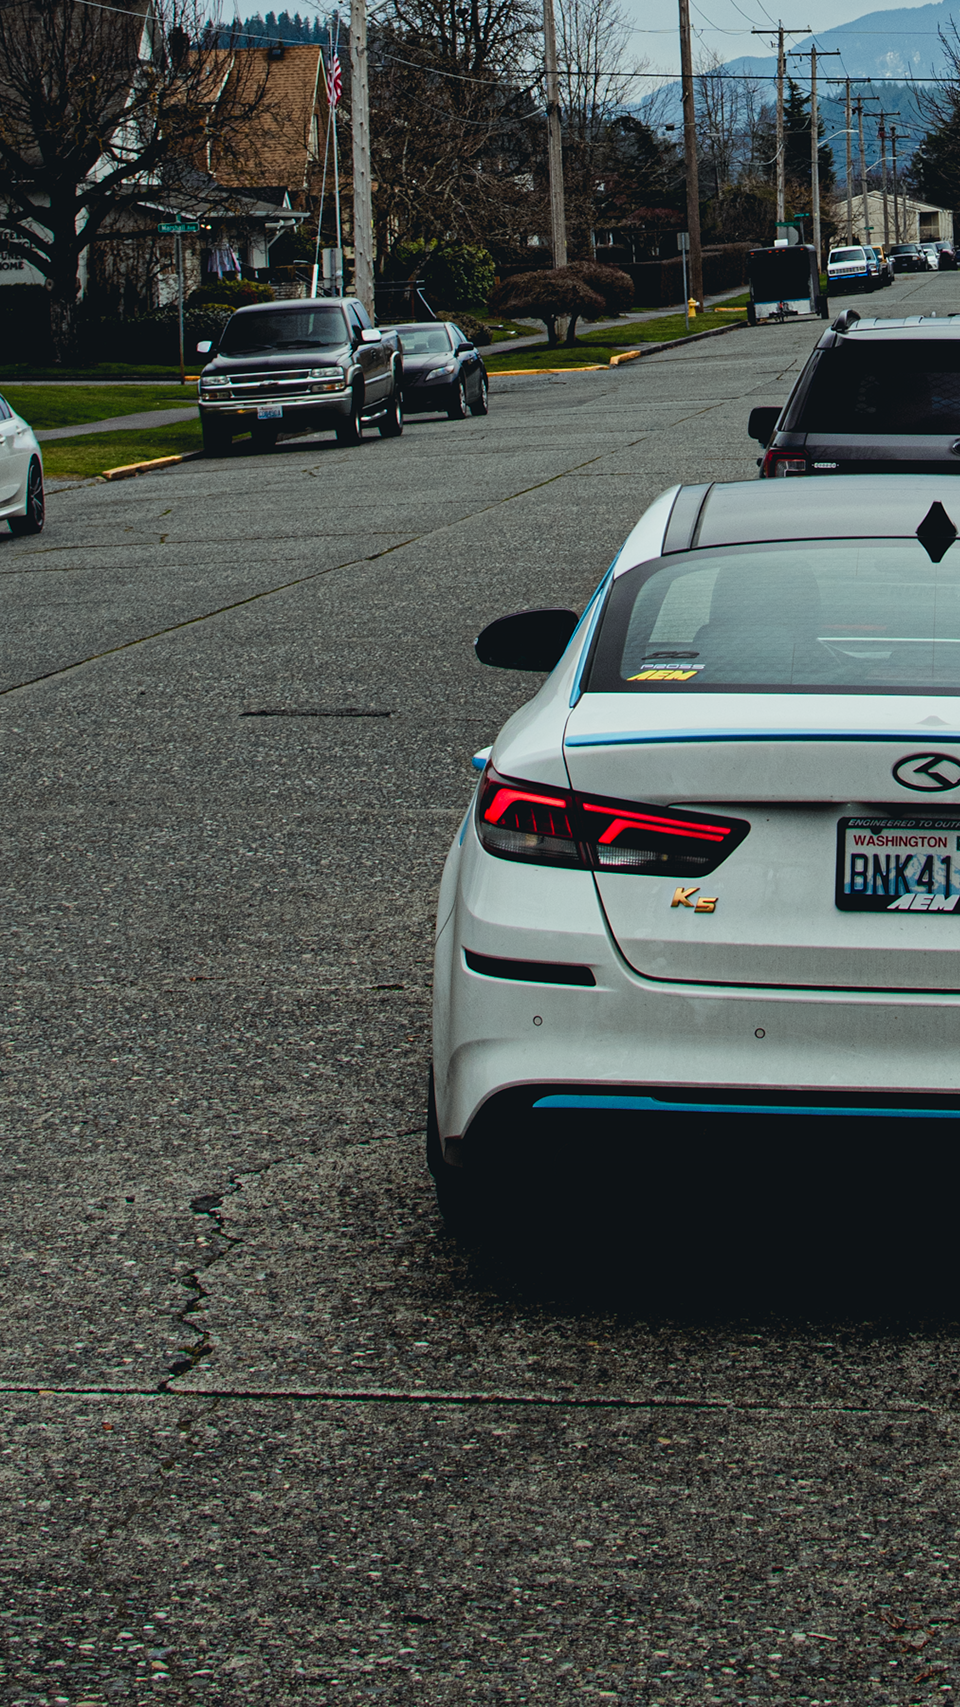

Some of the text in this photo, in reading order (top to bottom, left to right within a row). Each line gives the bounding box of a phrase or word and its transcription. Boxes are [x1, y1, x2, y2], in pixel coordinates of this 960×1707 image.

[0, 261, 25, 270] OME
[848, 818, 916, 828] ENGINEERED
[918, 819, 933, 828] TO
[853, 834, 948, 849] WASHINGTON
[670, 887, 719, 913] K5
[887, 893, 960, 911] AEM
